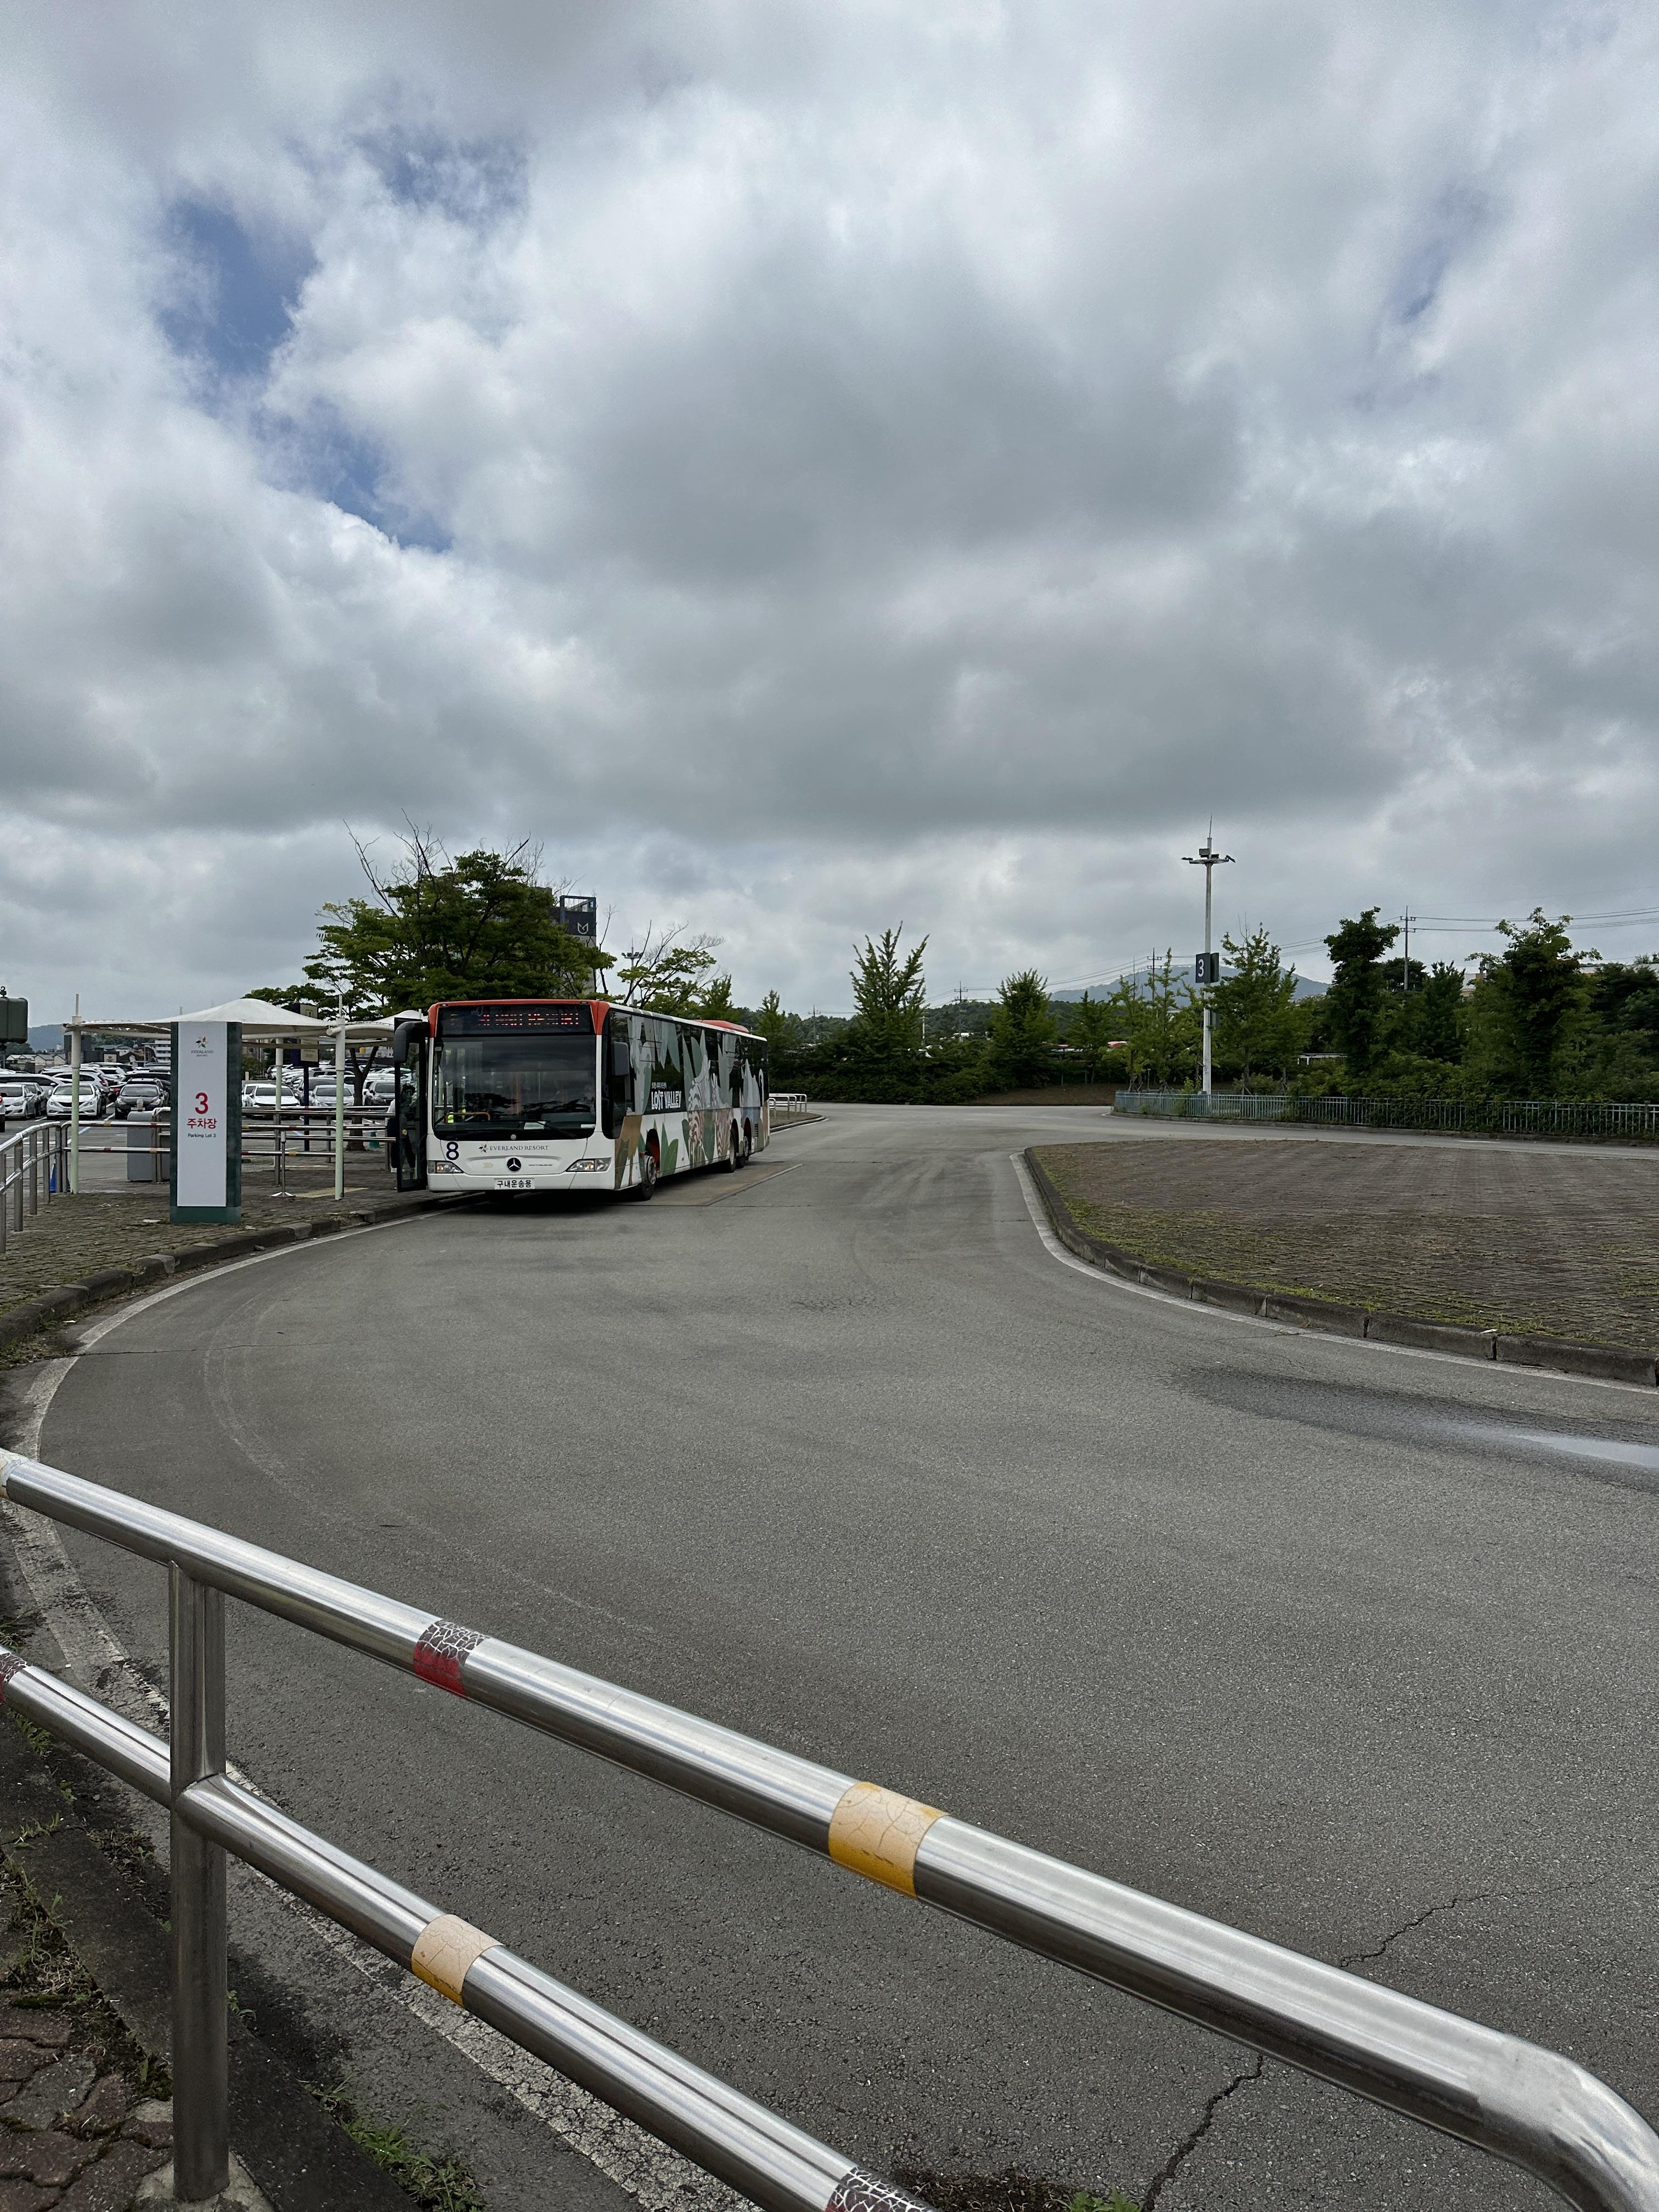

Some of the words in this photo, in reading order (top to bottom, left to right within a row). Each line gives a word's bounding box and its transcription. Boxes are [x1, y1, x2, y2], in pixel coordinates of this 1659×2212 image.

[1198, 959, 1204, 977] 3
[195, 1092, 208, 1114] 3
[651, 1090, 663, 1110] LOST
[664, 1091, 681, 1109] VALLEY
[187, 1118, 217, 1129] 주차장
[446, 1141, 459, 1160] 8
[496, 1180, 532, 1188] 구내운송용
